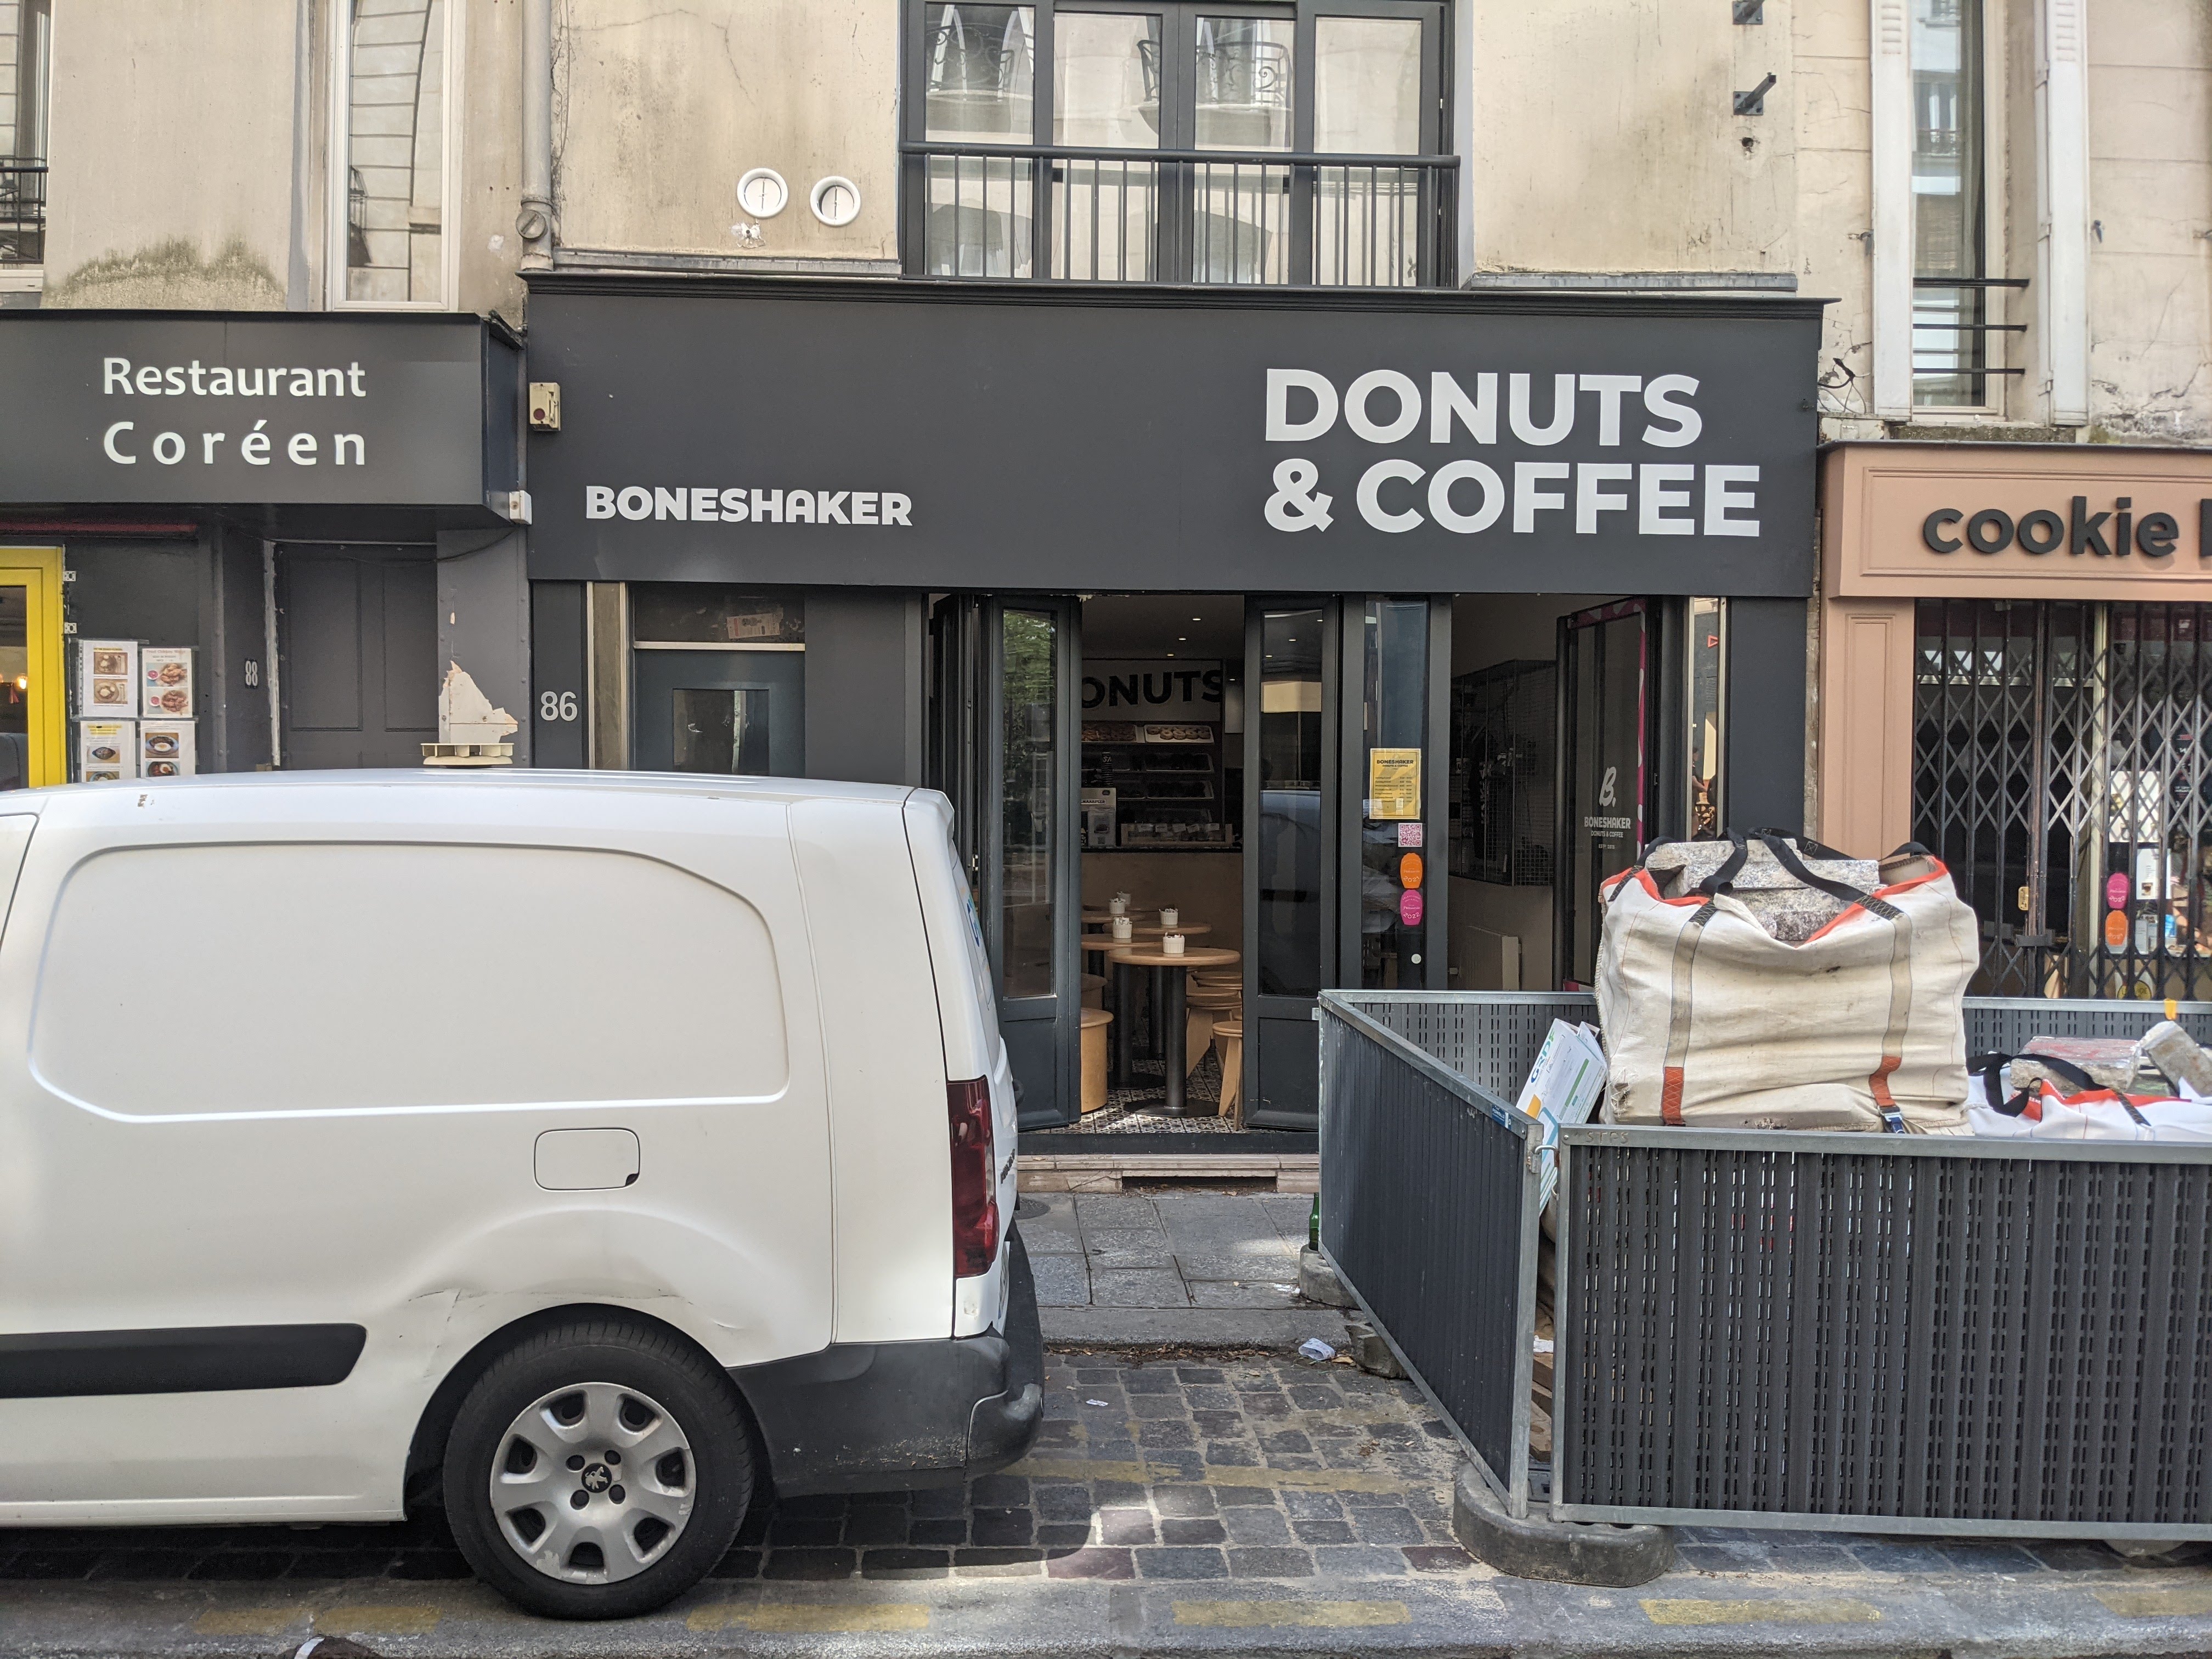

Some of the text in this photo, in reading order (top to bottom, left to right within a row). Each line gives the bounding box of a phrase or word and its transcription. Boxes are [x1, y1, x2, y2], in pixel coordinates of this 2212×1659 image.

[104, 358, 366, 398] Restaurant
[1266, 369, 1703, 448] DONUTS
[104, 419, 365, 466] Coréen
[586, 486, 913, 527] BONESHAKER
[1265, 459, 1760, 538] & COFFEE
[1923, 496, 2179, 557] cookie
[245, 661, 258, 687] 88
[540, 691, 578, 721] 86
[1584, 816, 1631, 829] BONESHAKER
